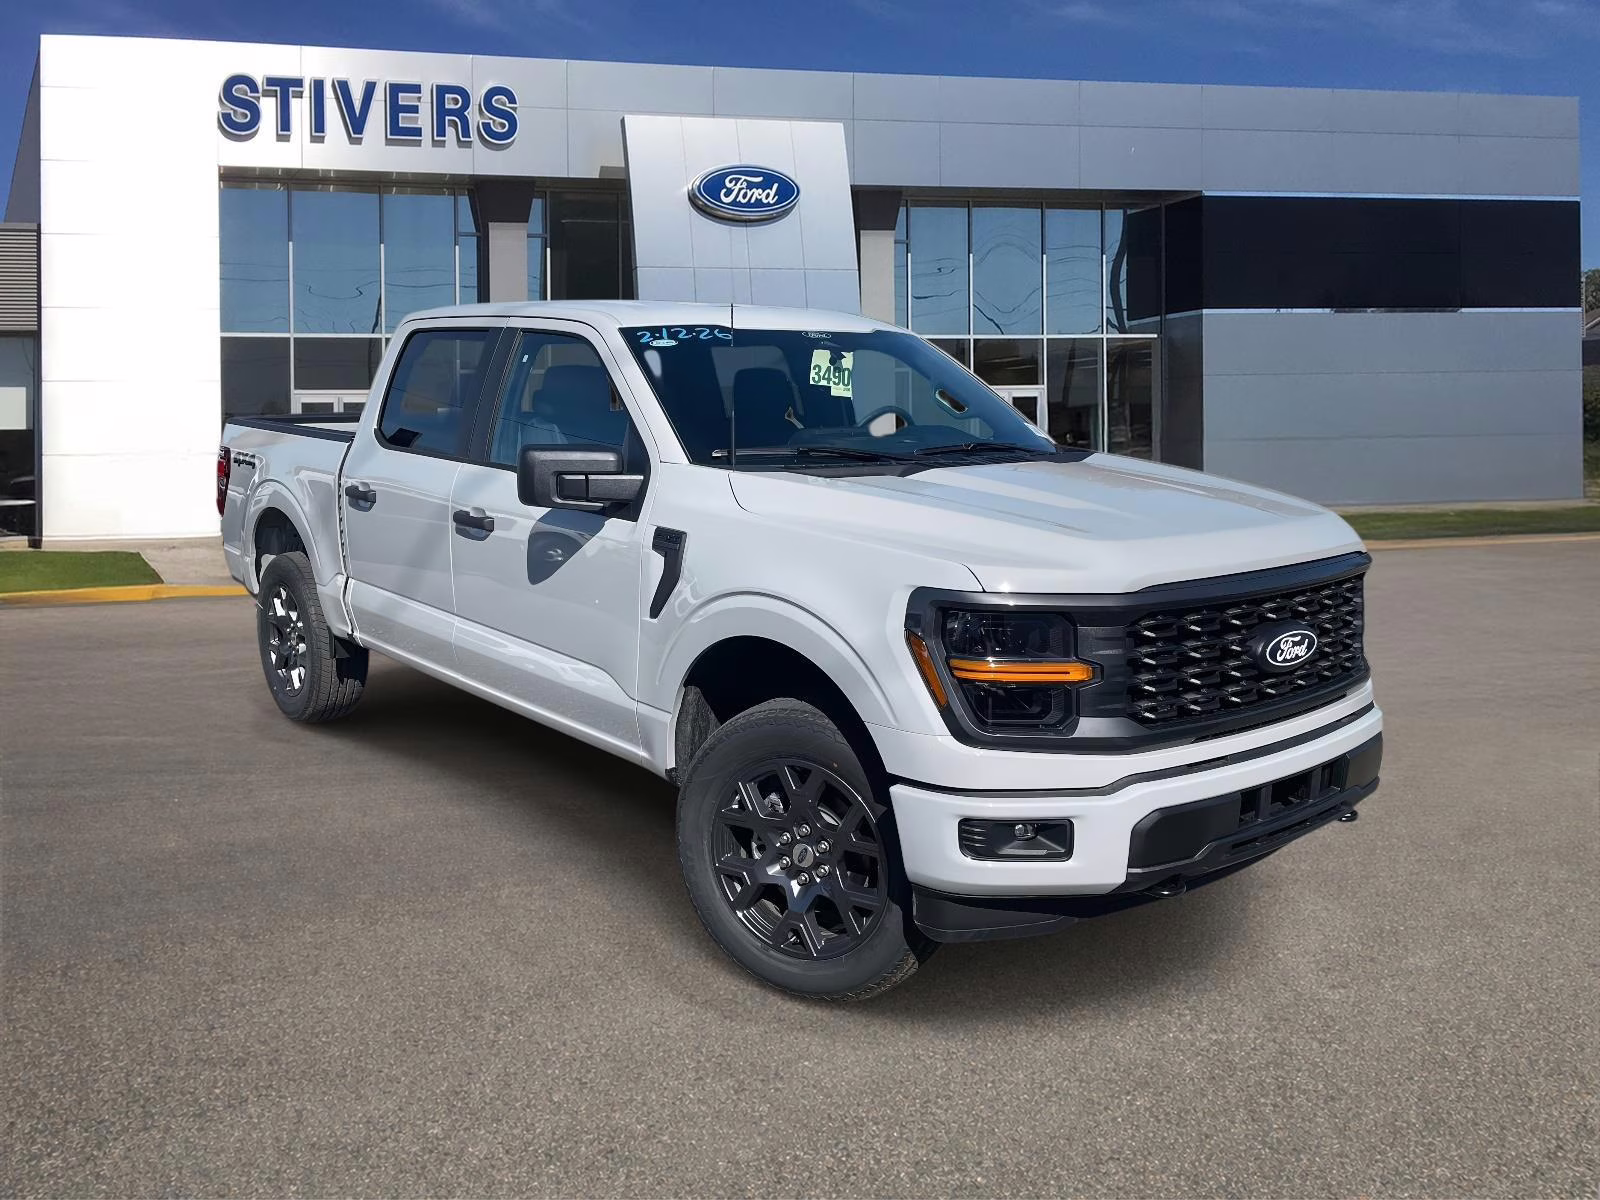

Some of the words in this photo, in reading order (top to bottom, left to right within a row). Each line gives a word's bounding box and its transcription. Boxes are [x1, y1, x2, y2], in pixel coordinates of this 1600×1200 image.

[218, 73, 519, 147] STIVERS
[720, 174, 779, 204] Ford
[811, 364, 851, 387] 3490
[1276, 635, 1309, 662] Ford
